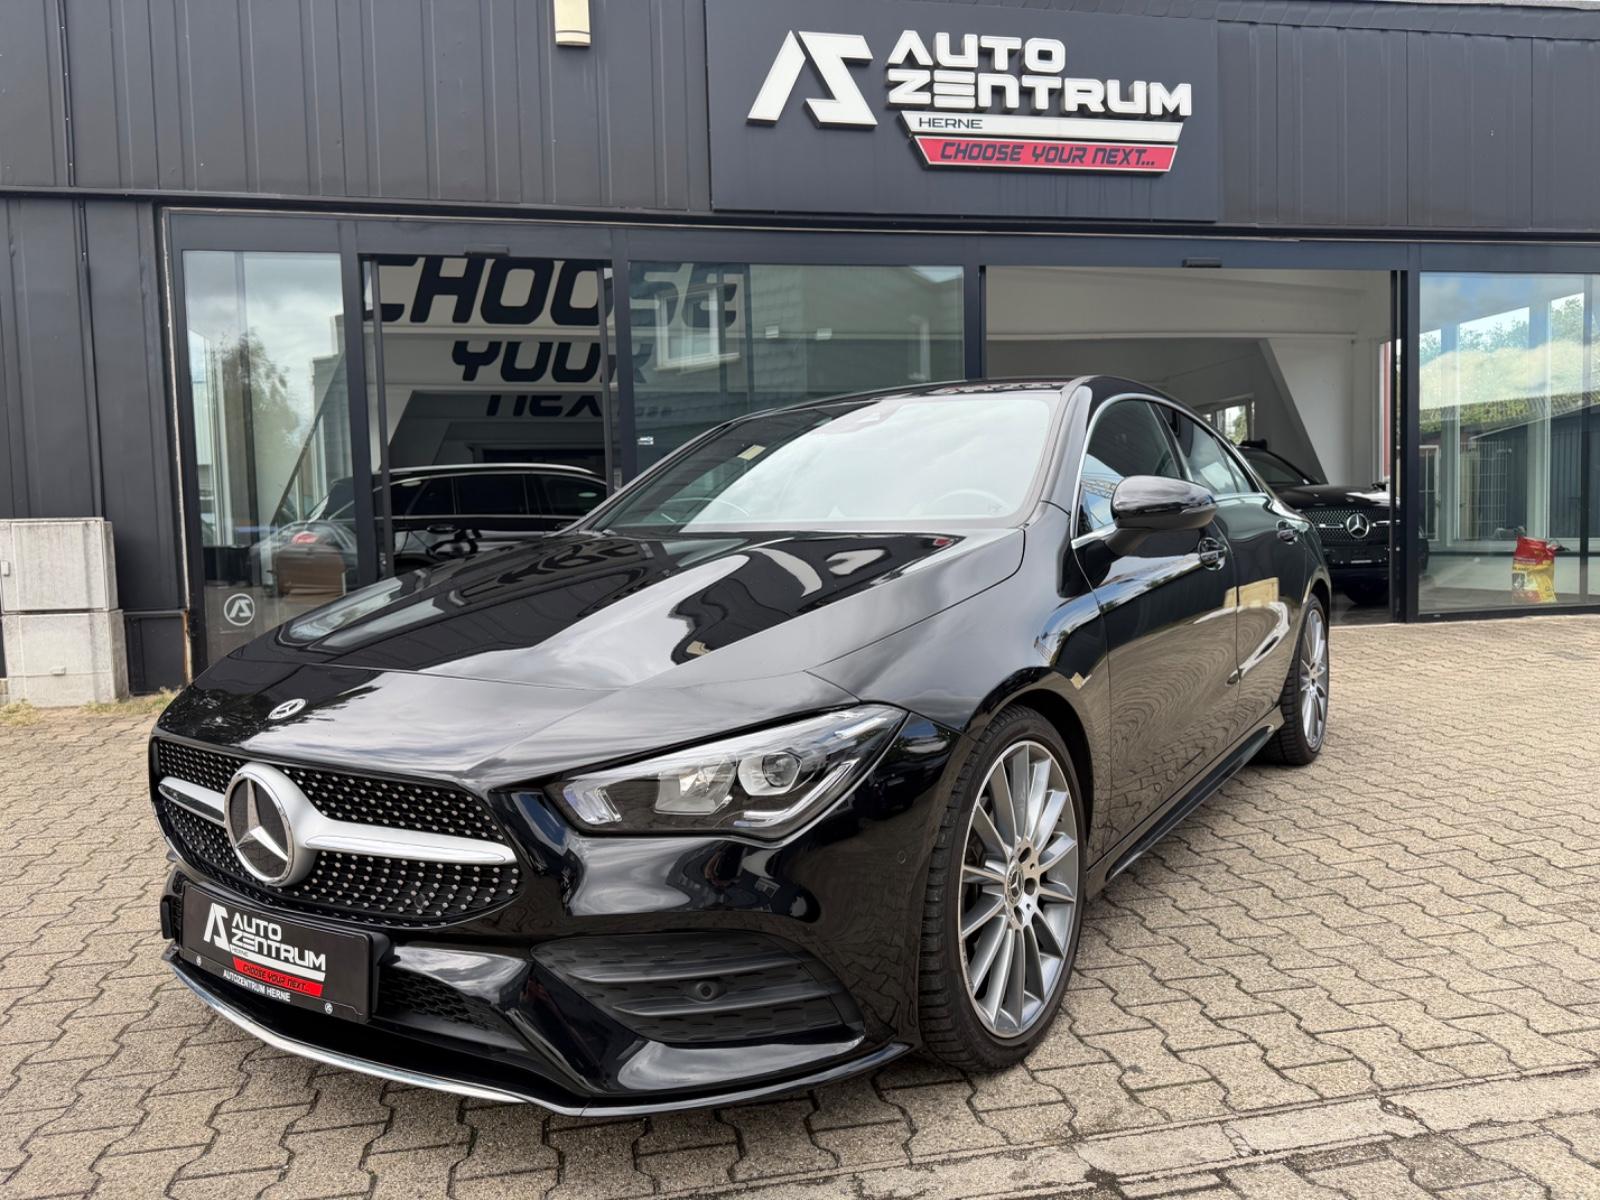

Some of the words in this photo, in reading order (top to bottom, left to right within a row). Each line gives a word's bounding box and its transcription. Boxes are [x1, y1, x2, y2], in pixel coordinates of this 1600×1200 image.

[887, 30, 1066, 73] AUTO
[888, 68, 1192, 116] ZENTRUM
[919, 117, 983, 129] HERNE
[940, 142, 1025, 162] CHOOSE
[1032, 144, 1088, 164] YOUR
[232, 912, 282, 941] AUTO
[231, 927, 326, 971] ZENTRUM
[223, 969, 266, 994] AUTOZENTRUM
[266, 986, 291, 1002] HERNE
[243, 965, 267, 978] CHOOSE
[267, 971, 285, 984] YOUR
